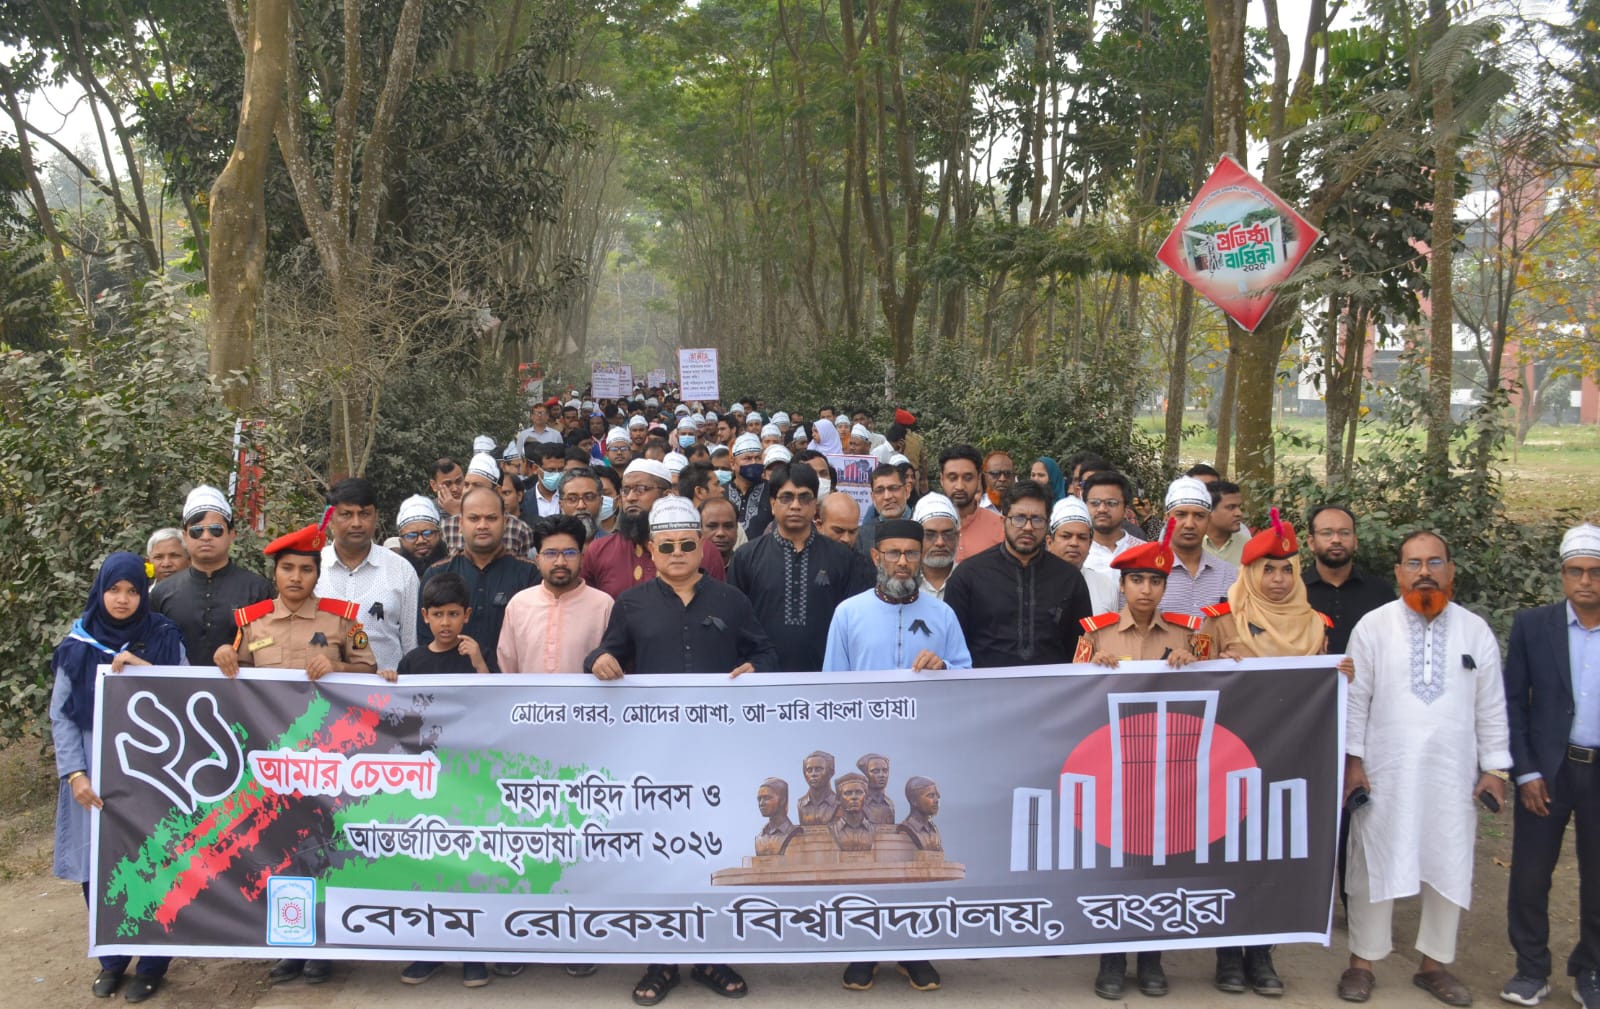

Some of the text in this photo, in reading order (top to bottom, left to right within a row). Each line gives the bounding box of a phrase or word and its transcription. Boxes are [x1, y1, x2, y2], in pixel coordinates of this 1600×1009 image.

[1216, 223, 1270, 251] প্রতিষ্ঠা
[1224, 242, 1275, 269] বার্ষিকী
[511, 698, 916, 726] মোদের গরব, মোদের আশা, আ-মরি বাংলা ভাষা।
[114, 690, 245, 814] ২১
[256, 754, 437, 793] আমার চেতনা
[501, 774, 721, 814] মহান শহিদ দিবস ও
[348, 818, 723, 870] আন্তর্জাতিক মাতৃভাষা দিবস ২০২৬
[341, 888, 1234, 940] বেগম রোকেয়া বিশ্ববিদ্যালয়, রংপুর
